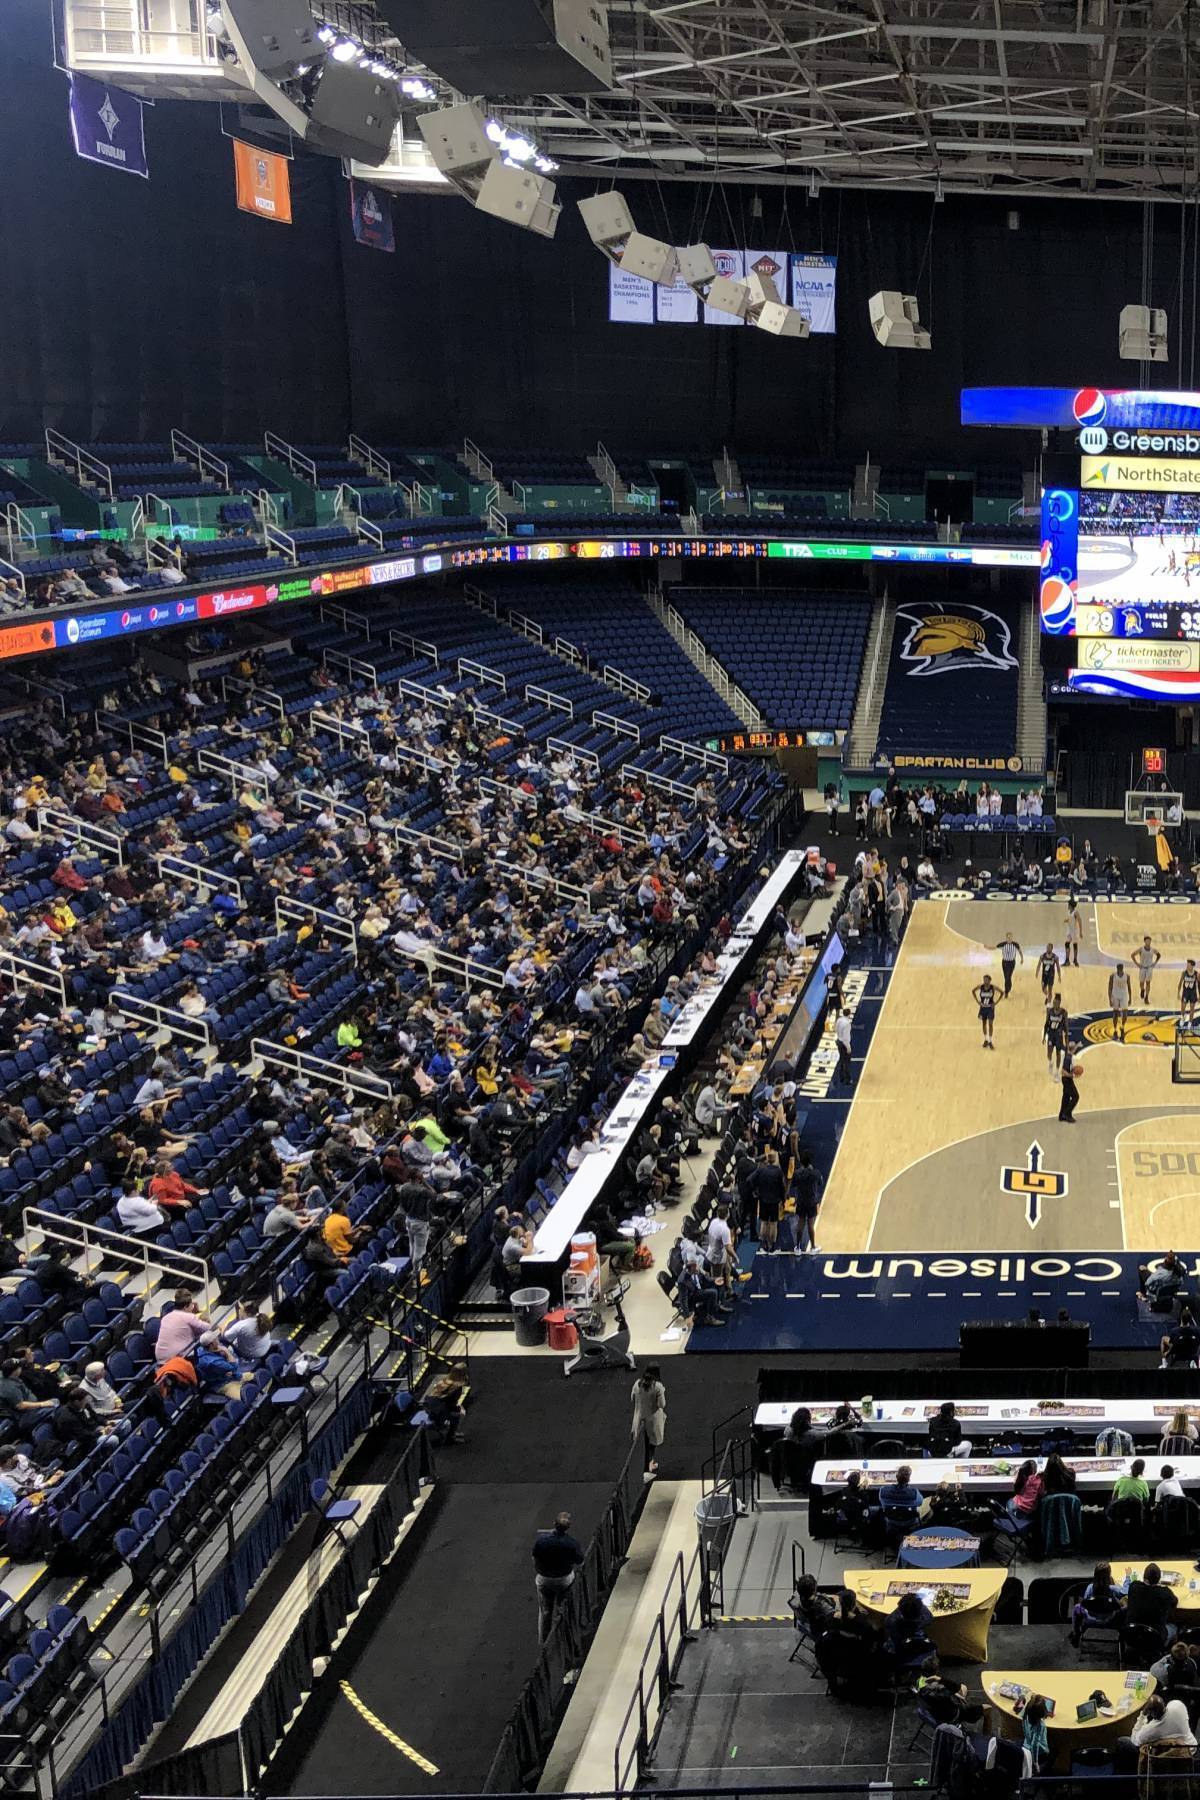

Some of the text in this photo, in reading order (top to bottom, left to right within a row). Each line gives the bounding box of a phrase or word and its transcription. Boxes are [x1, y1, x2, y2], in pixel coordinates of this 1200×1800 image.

[758, 264, 775, 272] NIT
[796, 281, 824, 291] NCAA
[613, 291, 650, 299] CHAMPIONS
[537, 546, 549, 560] 29
[600, 544, 614, 557] 26
[782, 543, 814, 558] TFA
[212, 591, 254, 614] Budweiser
[79, 617, 106, 630] Greensboro
[1085, 612, 1114, 633] 29
[79, 627, 102, 638] Coliseum
[1116, 645, 1185, 658] ticketmaster
[1151, 658, 1181, 666] TICKETS
[894, 755, 1006, 769] SPARTAN CLUB
[1147, 758, 1162, 771] 30
[985, 891, 1191, 904] Greensboro
[822, 1257, 1123, 1283] Coliseum
